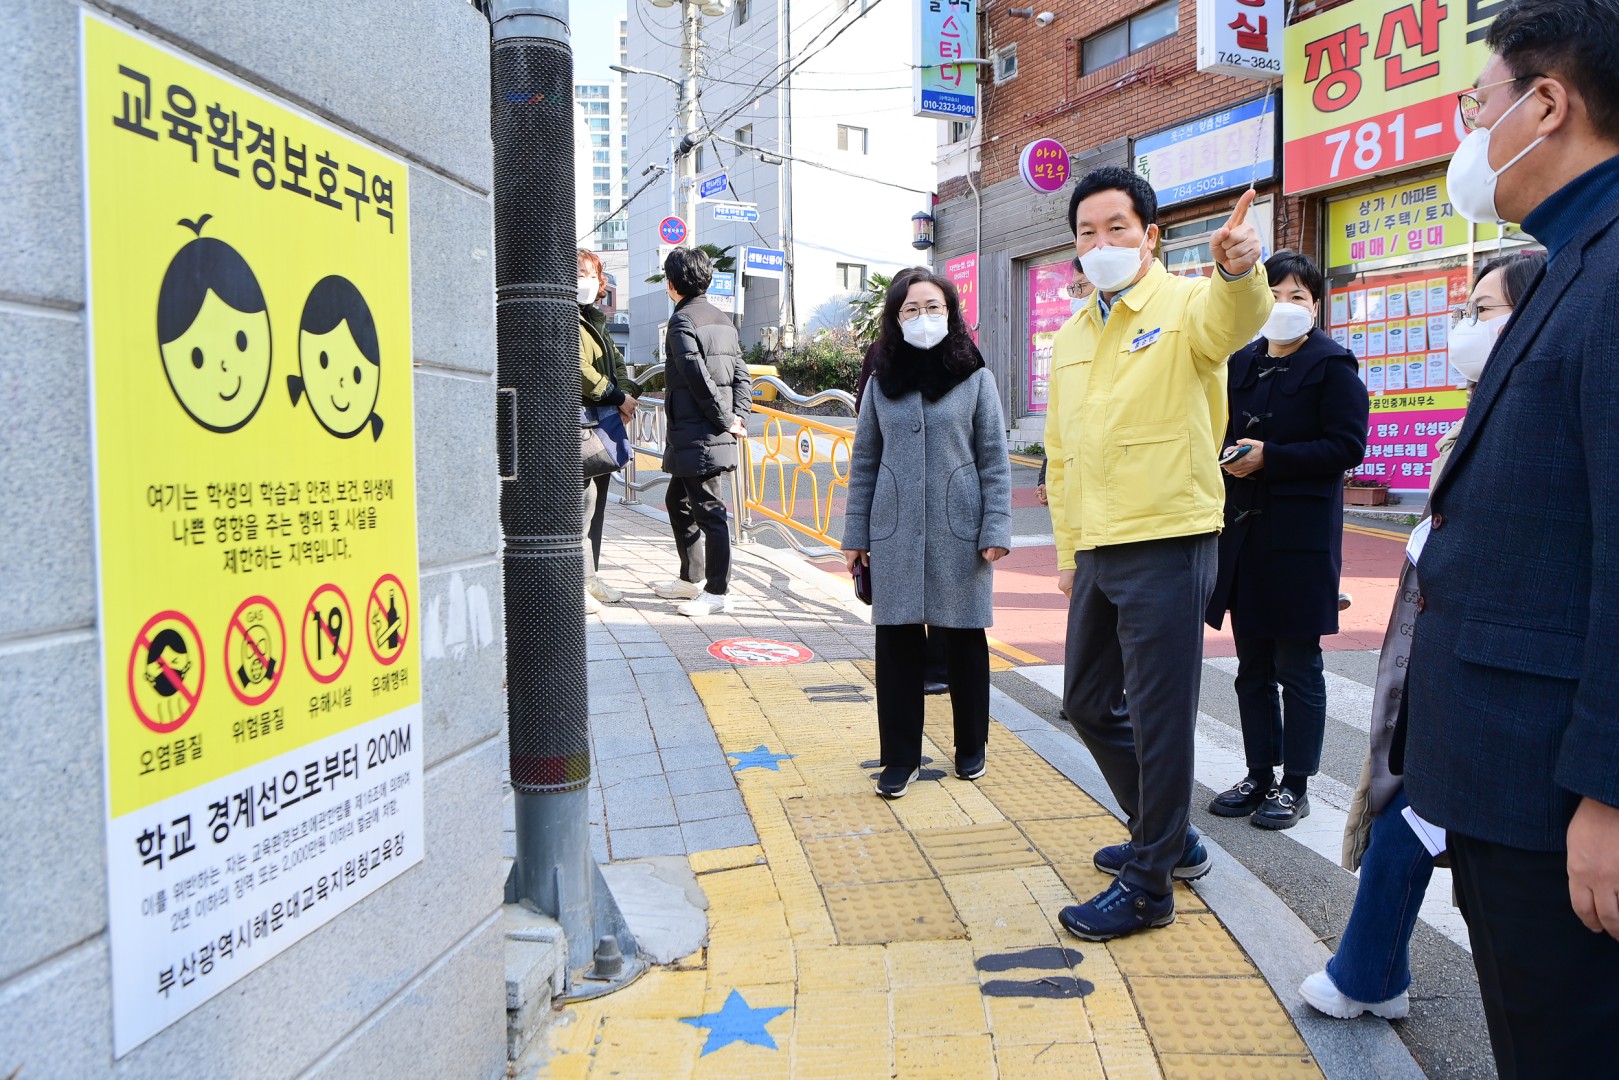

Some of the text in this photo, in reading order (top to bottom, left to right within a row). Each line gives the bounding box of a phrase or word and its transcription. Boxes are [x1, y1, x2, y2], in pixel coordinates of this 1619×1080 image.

[940, 15, 962, 87] 스터디
[1218, 51, 1281, 71] 742-3843
[1304, 0, 1448, 113] 장산
[923, 99, 974, 114] 010-2323-9901
[1170, 112, 1231, 143] 옷수선 맞춤전문
[1325, 96, 1474, 178] 781-
[113, 64, 394, 235] 교육환경보호구역
[1036, 147, 1063, 160] 아이
[1034, 163, 1066, 182] 브로우
[1173, 175, 1225, 199] 784-5034
[1359, 197, 1385, 217] 상가
[1401, 185, 1438, 206] 아파트
[1345, 221, 1371, 239] 빌라
[1384, 210, 1411, 230] 주택
[1425, 202, 1454, 222] 토지
[1351, 237, 1384, 260] 매매
[1407, 225, 1443, 251] 임대
[1377, 424, 1399, 437] 명유
[147, 483, 198, 512] 여기는
[206, 481, 253, 509] 학생의
[260, 481, 300, 507] 학습과
[172, 506, 378, 546] 나쁜 영향을 주는 행위 및 시설을
[223, 537, 352, 573] 제한하는 지역입니다.
[246, 609, 264, 624] GAS
[313, 606, 343, 660] 19
[371, 668, 408, 698] 유해행위
[308, 685, 353, 719] 유해시설
[232, 707, 284, 743] 위험물질
[139, 733, 203, 776] 오염물질
[136, 723, 412, 870] 학교 경계선으로부터 200M
[141, 889, 167, 917] 이를
[173, 866, 221, 902] 위반하는
[225, 853, 247, 874] 자는
[390, 771, 410, 792] 의하여
[171, 906, 191, 932] 2년
[195, 885, 230, 917] 이하의
[235, 873, 255, 899] 징역
[259, 863, 279, 885] 또는
[282, 834, 327, 872] 2,000만원
[329, 821, 354, 846] 이하의
[358, 807, 379, 833] 벌금에
[157, 832, 405, 999] 부산광역시해운대교육지원청교육장
